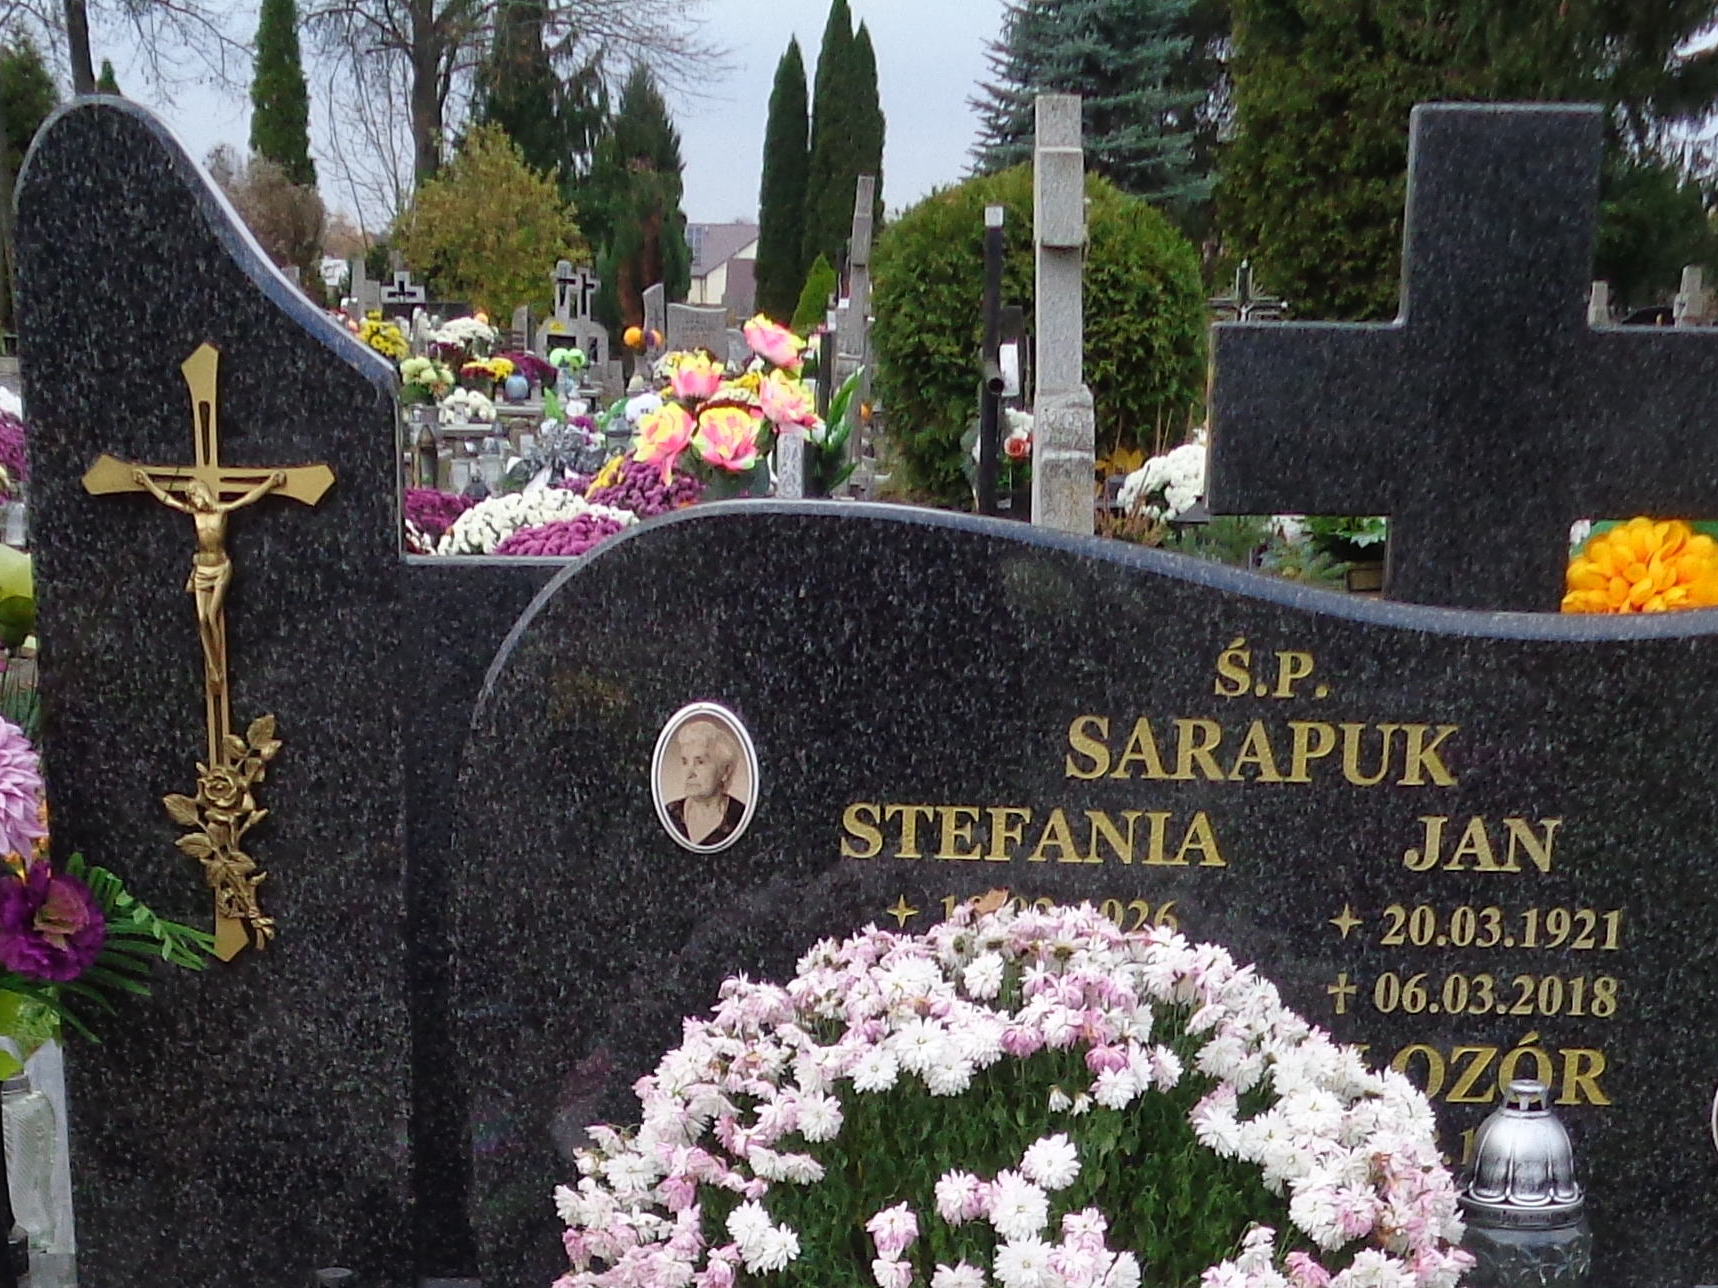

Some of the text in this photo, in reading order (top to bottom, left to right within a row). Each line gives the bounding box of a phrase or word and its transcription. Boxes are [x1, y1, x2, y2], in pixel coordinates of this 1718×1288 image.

[1215, 638, 1328, 698] Ś.P.
[1066, 715, 1458, 785] SARAPUK
[840, 803, 1226, 866] STEFANIA
[1404, 816, 1562, 873] JAN
[1380, 904, 1621, 949] 20.03.1921
[1374, 972, 1619, 1018] 06.03.2018
[1351, 1031, 1612, 1106] OZÓR
